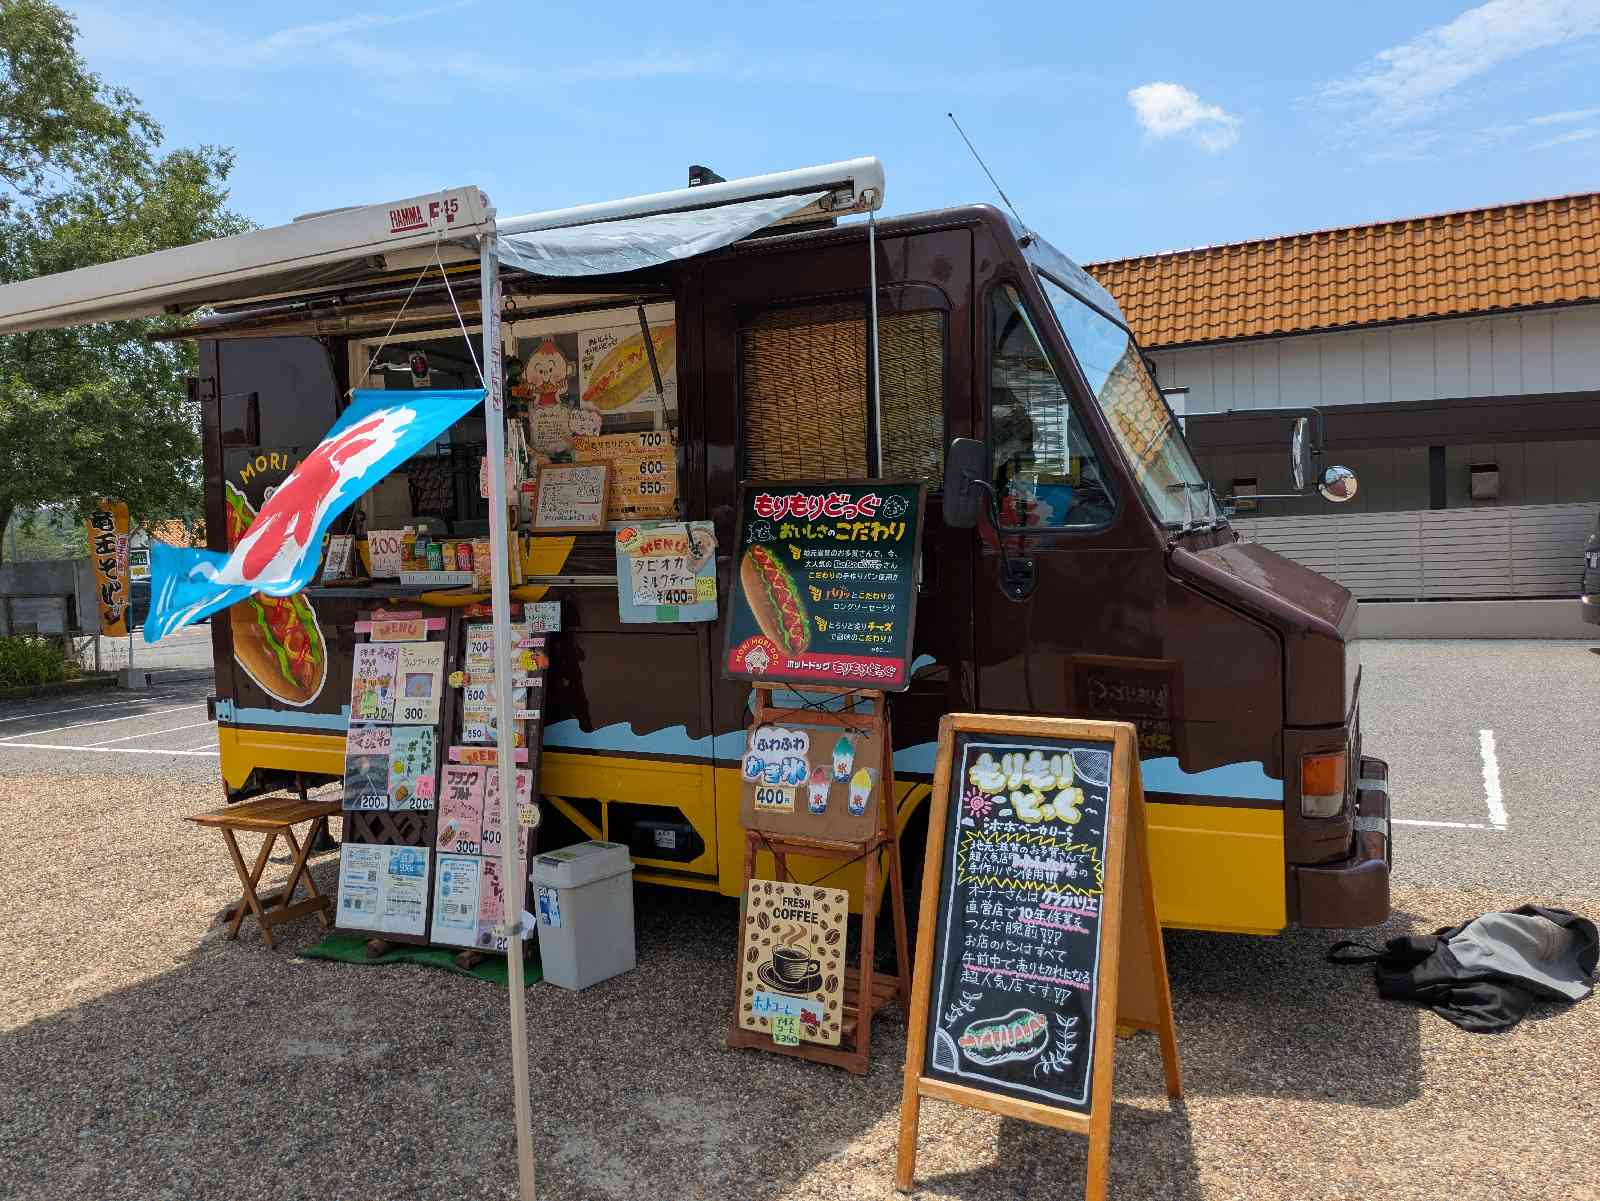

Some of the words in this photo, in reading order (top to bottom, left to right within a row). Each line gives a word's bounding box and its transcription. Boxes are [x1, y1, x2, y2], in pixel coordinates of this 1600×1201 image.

[389, 206, 424, 229] FIAMMA
[239, 452, 288, 484] MORI
[754, 492, 882, 521] もりもりどっぐ
[779, 521, 906, 543] おいしさのこだわり
[787, 660, 830, 671] ホットドッグ
[757, 737, 804, 751] ふわふわ
[448, 771, 479, 785] フランク
[969, 751, 1075, 795] もりもり
[783, 897, 811, 909] FRESH
[773, 907, 819, 925] COFFEE
[964, 933, 1068, 962] お店のパンはすべて
